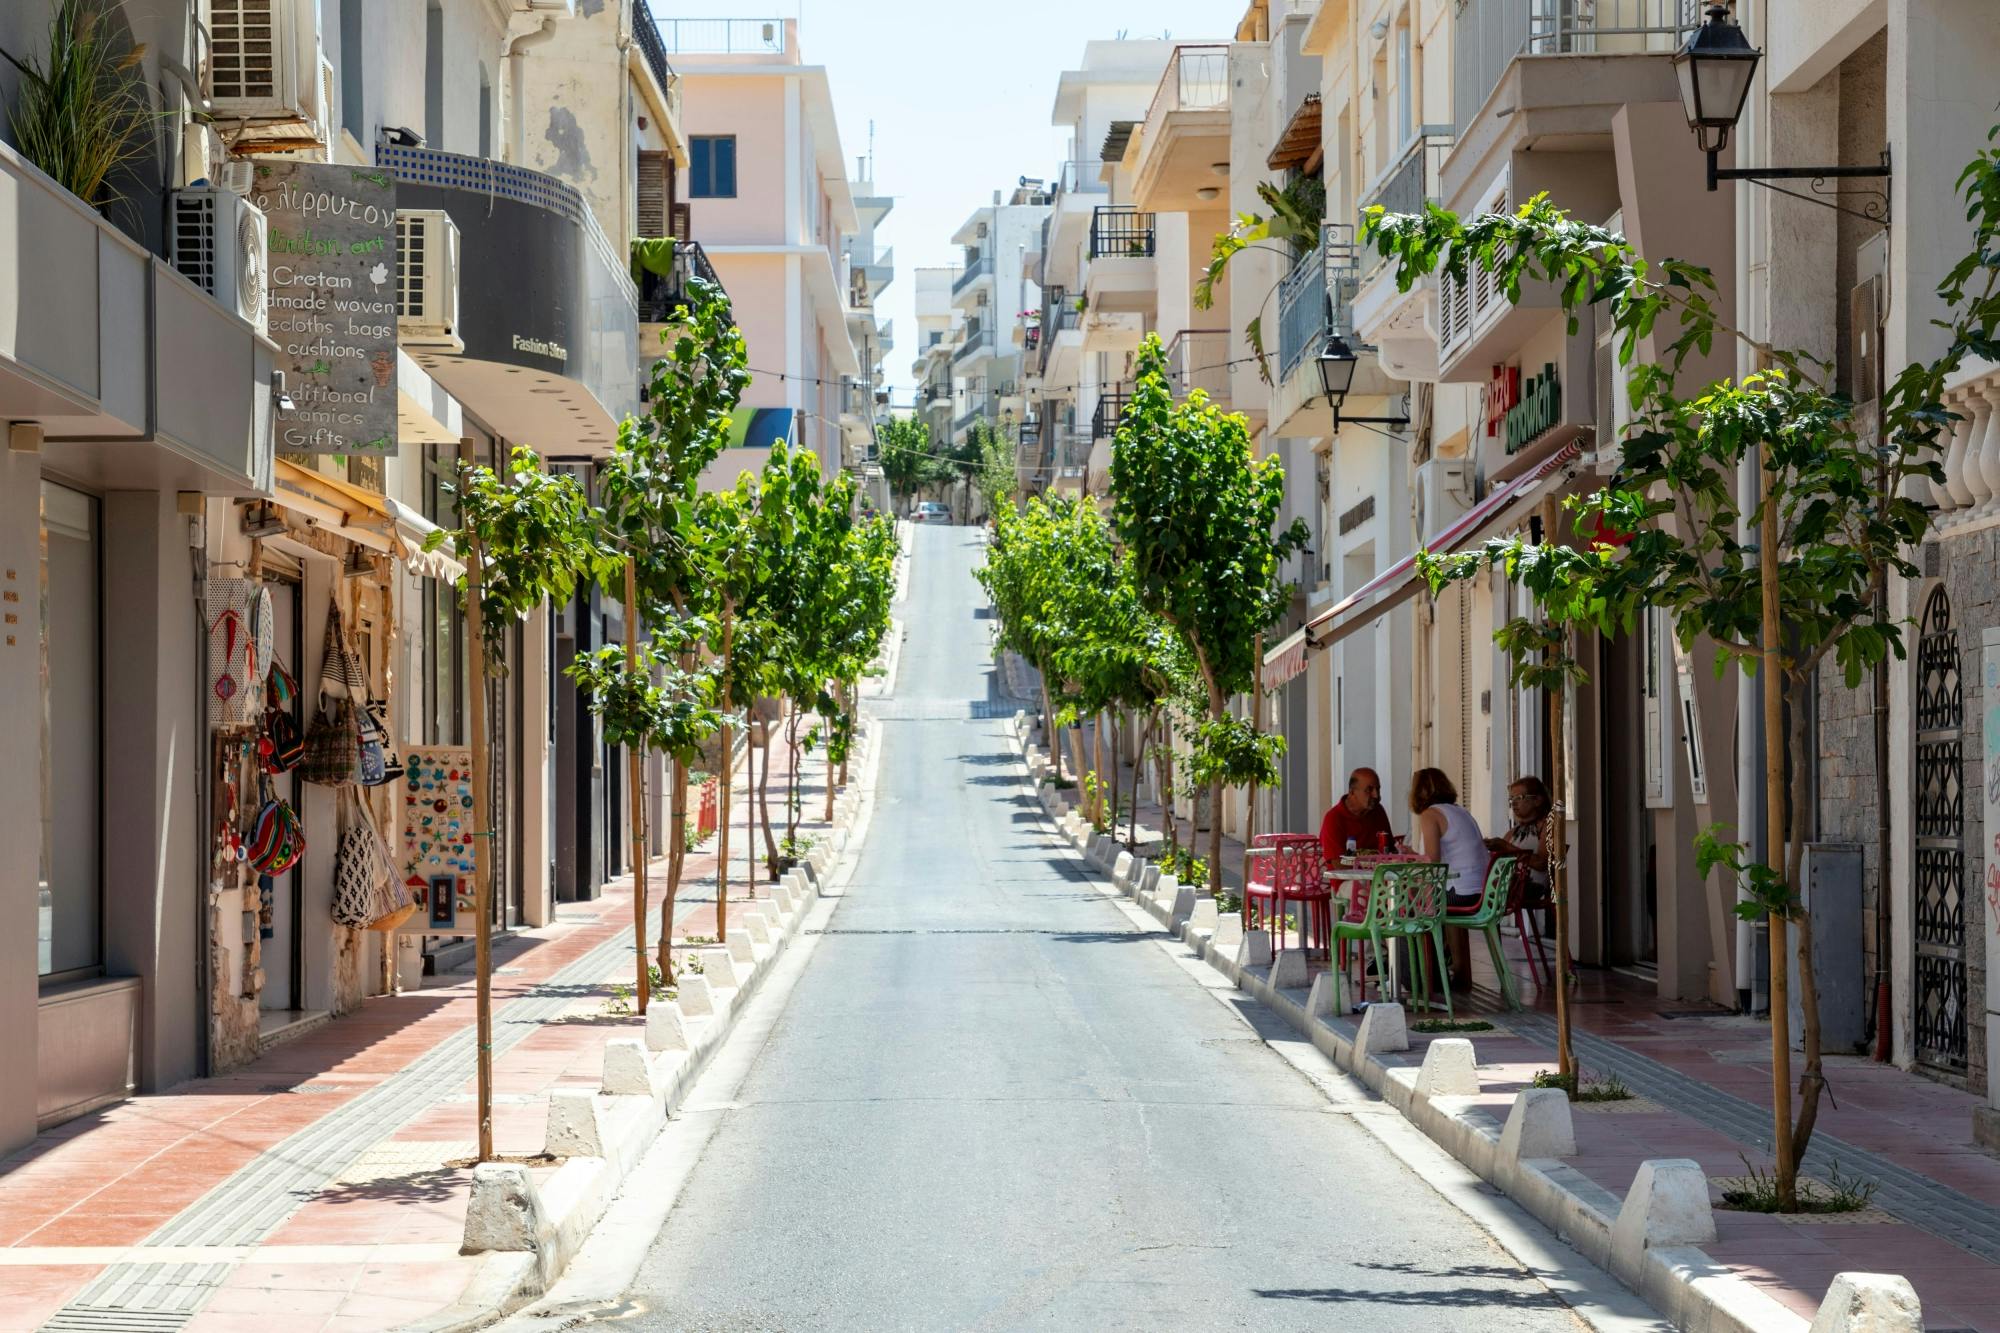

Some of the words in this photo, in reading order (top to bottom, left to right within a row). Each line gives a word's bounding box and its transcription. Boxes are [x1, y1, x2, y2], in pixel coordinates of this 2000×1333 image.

[350, 234, 385, 255] art
[272, 265, 352, 289] Cretan
[267, 288, 326, 310] dmade
[334, 299, 395, 315] woven
[267, 314, 335, 334] ecloths
[287, 338, 366, 359] cushions
[513, 334, 549, 355] Fashion
[285, 382, 375, 404] ditional
[1487, 366, 1516, 436] pizza
[277, 407, 364, 425] amics
[283, 427, 344, 446] Gifts
